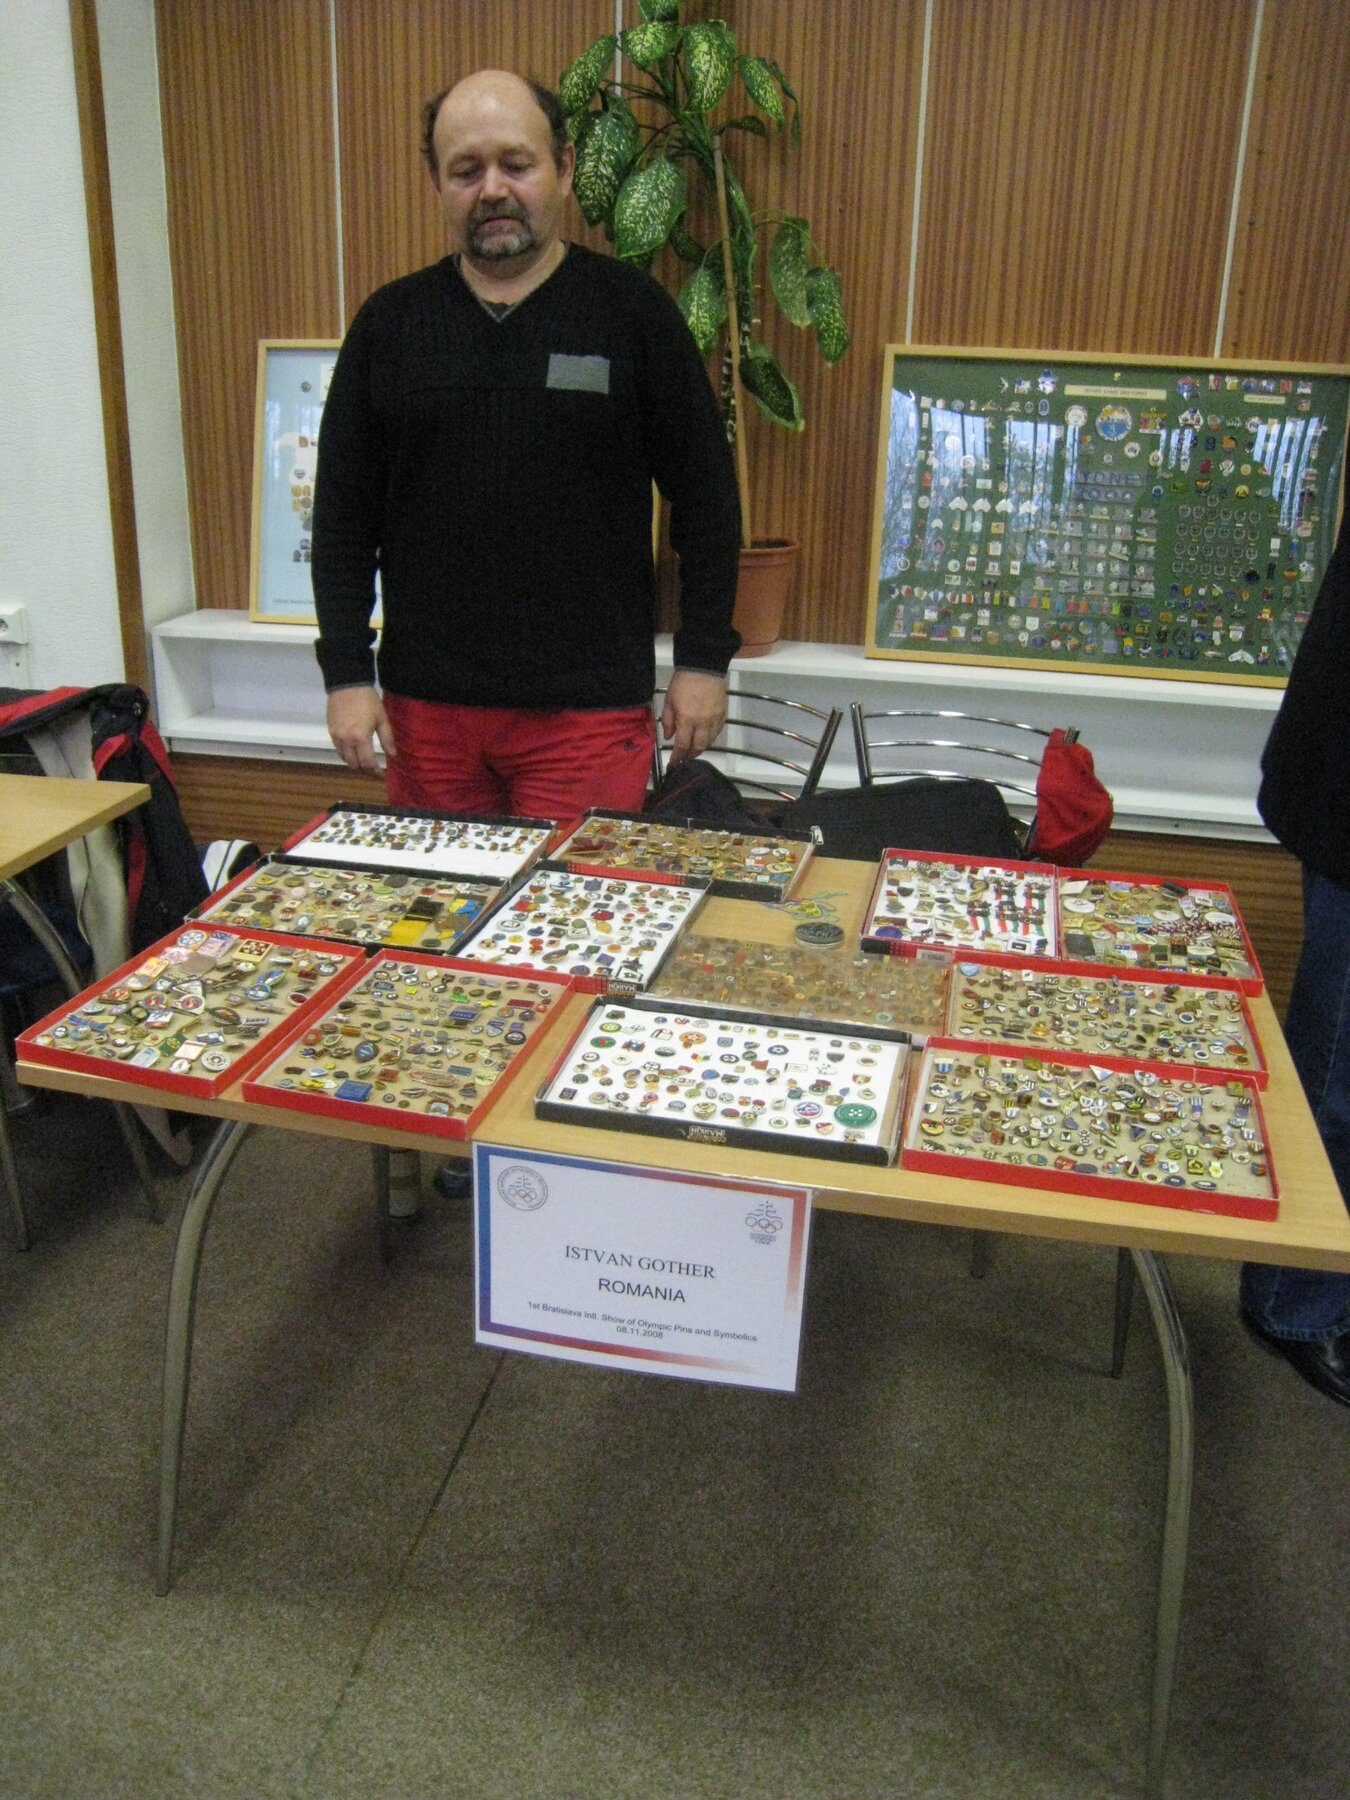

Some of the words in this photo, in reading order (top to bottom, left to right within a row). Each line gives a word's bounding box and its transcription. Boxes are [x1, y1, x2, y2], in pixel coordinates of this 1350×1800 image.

[565, 1245, 632, 1267] ISTVAN
[638, 1256, 716, 1279] GOTHER
[598, 1278, 686, 1303] ROMANIA
[528, 1301, 540, 1310] 1st
[542, 1303, 582, 1318] Bratislava
[584, 1311, 599, 1320] Intl.
[601, 1313, 625, 1325] Show
[627, 1318, 636, 1326] of
[637, 1319, 672, 1332] Olympic
[673, 1324, 692, 1334] Pins
[694, 1328, 711, 1337] and
[713, 1329, 758, 1342] Symbolics
[616, 1325, 664, 1339] 08.11.2008
